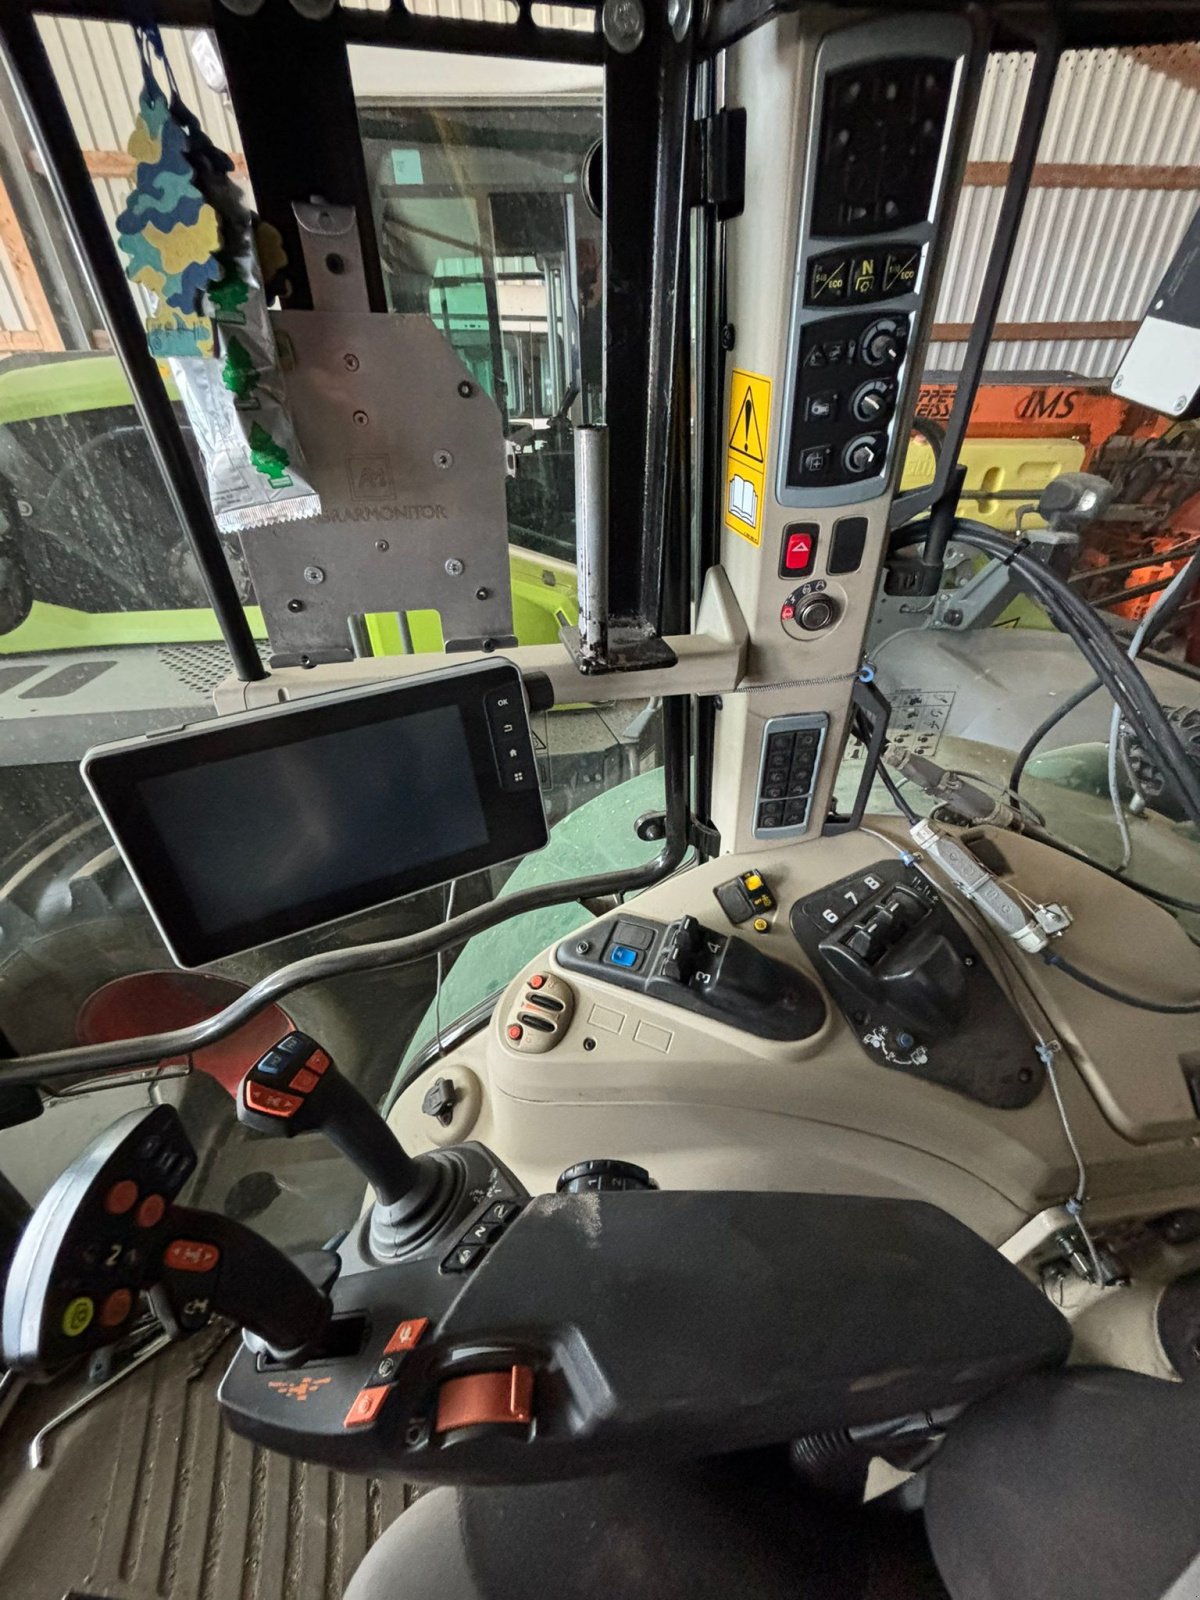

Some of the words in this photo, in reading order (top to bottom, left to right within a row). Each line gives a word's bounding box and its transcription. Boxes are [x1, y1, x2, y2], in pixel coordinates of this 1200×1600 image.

[862, 260, 874, 275] N
[900, 270, 915, 280] ECO
[828, 279, 843, 289] ECO
[310, 504, 448, 524] GRARMONITOR
[497, 698, 509, 707] OK
[822, 908, 839, 924] 6
[843, 890, 859, 905] 7
[863, 876, 880, 890] 8
[695, 970, 711, 984] 3
[707, 941, 721, 954] 4
[105, 1244, 122, 1266] 2
